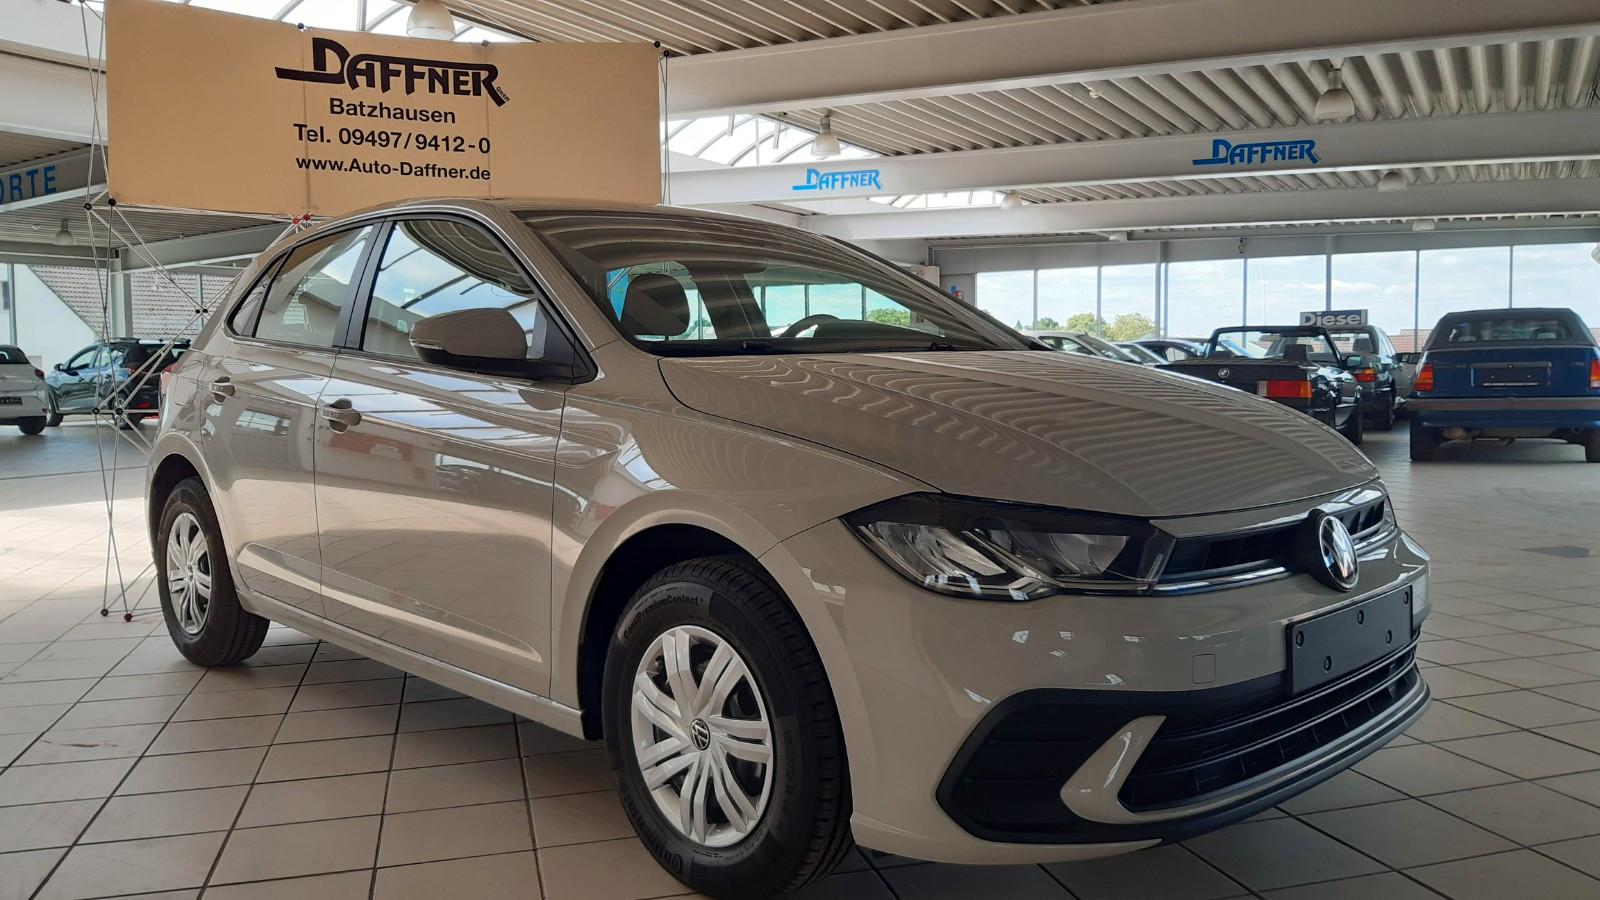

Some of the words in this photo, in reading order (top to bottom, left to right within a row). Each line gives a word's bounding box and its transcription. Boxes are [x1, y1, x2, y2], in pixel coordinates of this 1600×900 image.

[274, 37, 506, 107] DAFFNER
[329, 97, 456, 124] Batzhausen
[293, 123, 331, 144] Tel.
[1192, 138, 1320, 165] DAFFNER
[296, 156, 491, 181] www.Auto-Daffner.de
[792, 167, 881, 191] DAFFNER
[0, 165, 57, 205] RTE
[1300, 311, 1367, 327] Diesel
